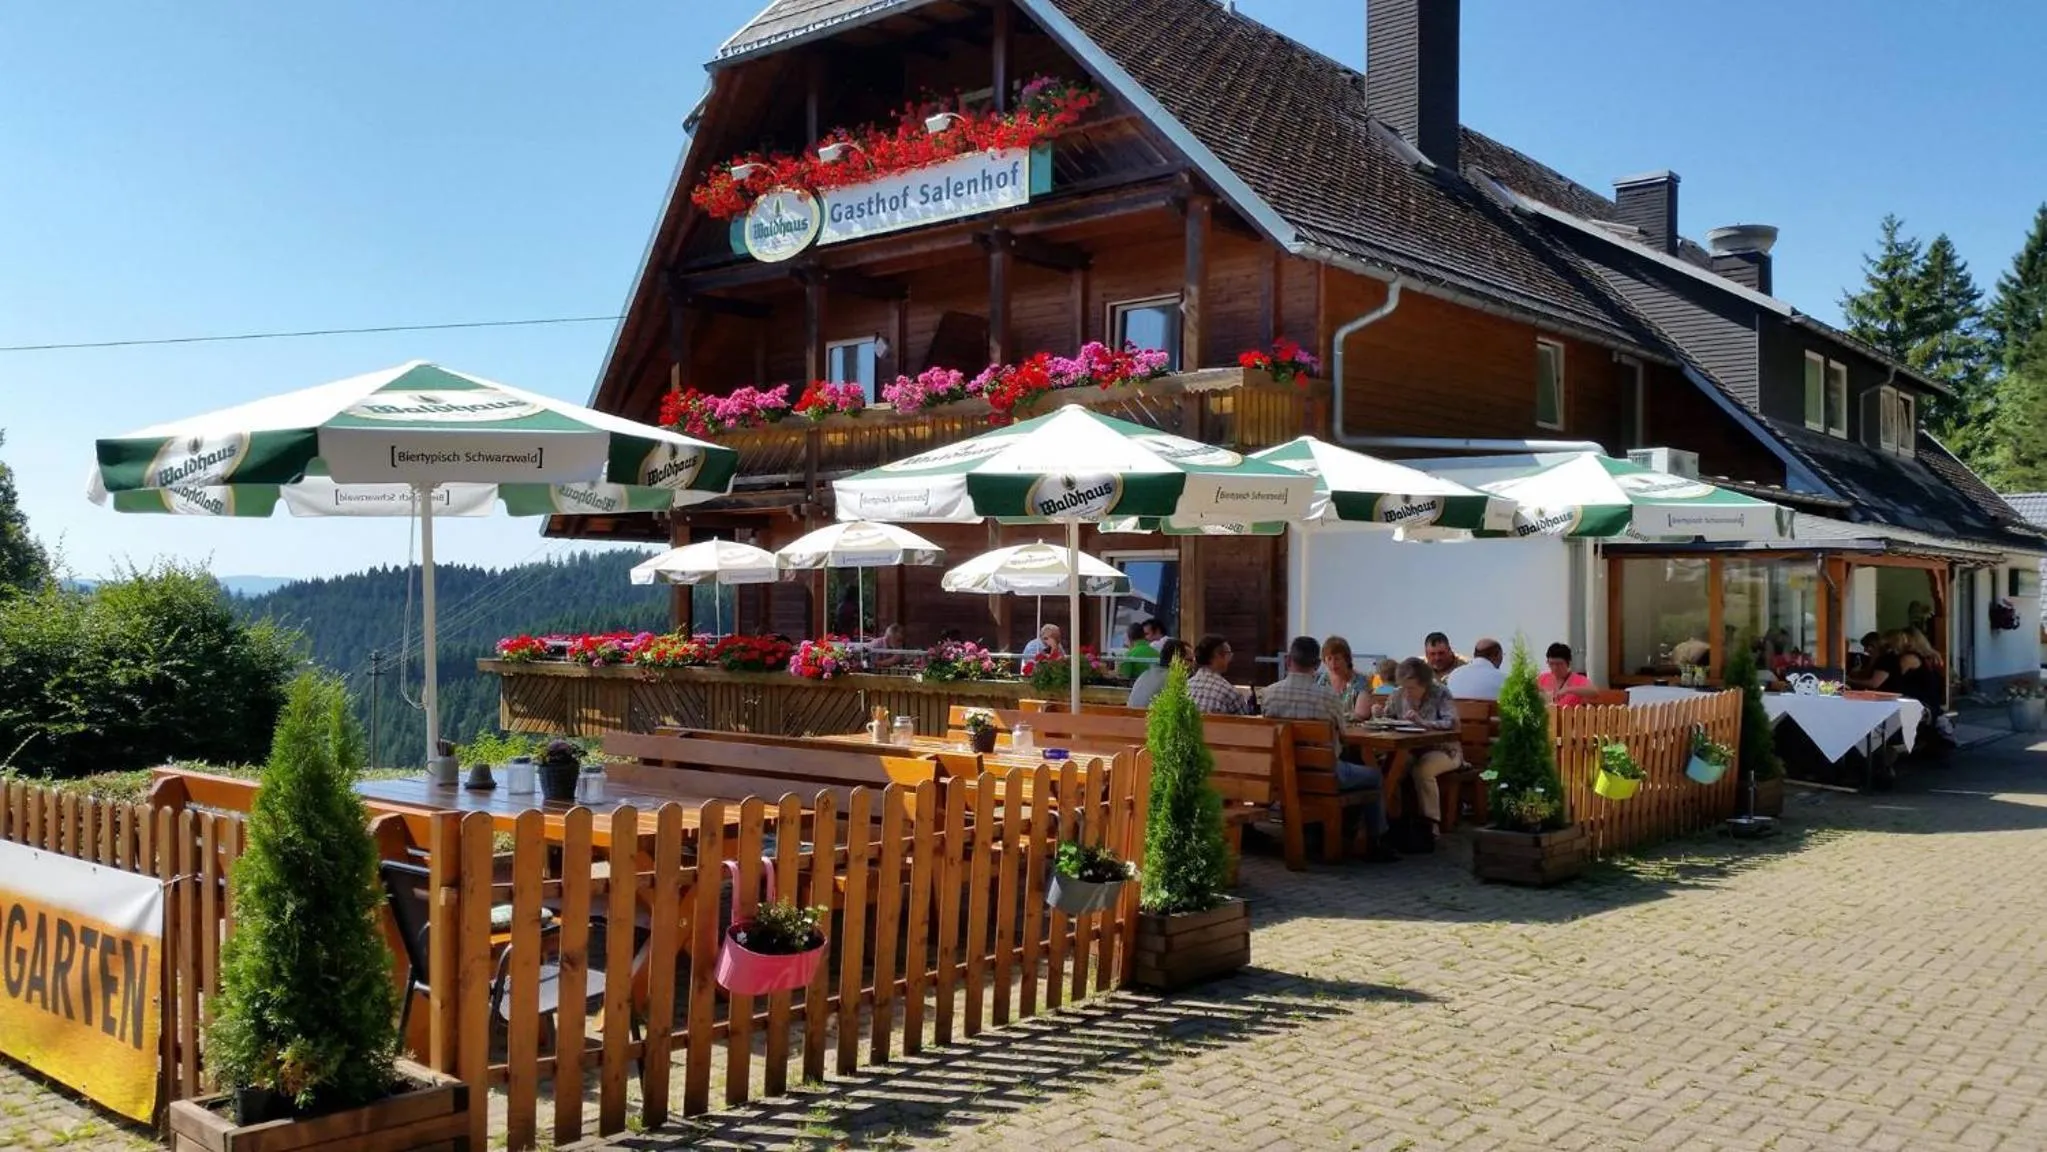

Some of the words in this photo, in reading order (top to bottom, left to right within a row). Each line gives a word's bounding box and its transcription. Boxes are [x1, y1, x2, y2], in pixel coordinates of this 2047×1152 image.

[830, 186, 910, 224] Gasthof
[919, 161, 1020, 206] Salenhof
[752, 217, 809, 240] Waldhaus
[361, 399, 528, 414] Waldhaus
[157, 443, 237, 487] Waldhaus
[390, 445, 461, 468] [Biertypisch
[465, 447, 543, 469] Schwarzwald]
[647, 455, 699, 487] Waldhaus
[1038, 482, 1113, 516] Waldhaus
[1383, 499, 1437, 523] Waldhaus
[1517, 511, 1574, 537] Waldhaus
[0, 903, 149, 1050] GARTEN
